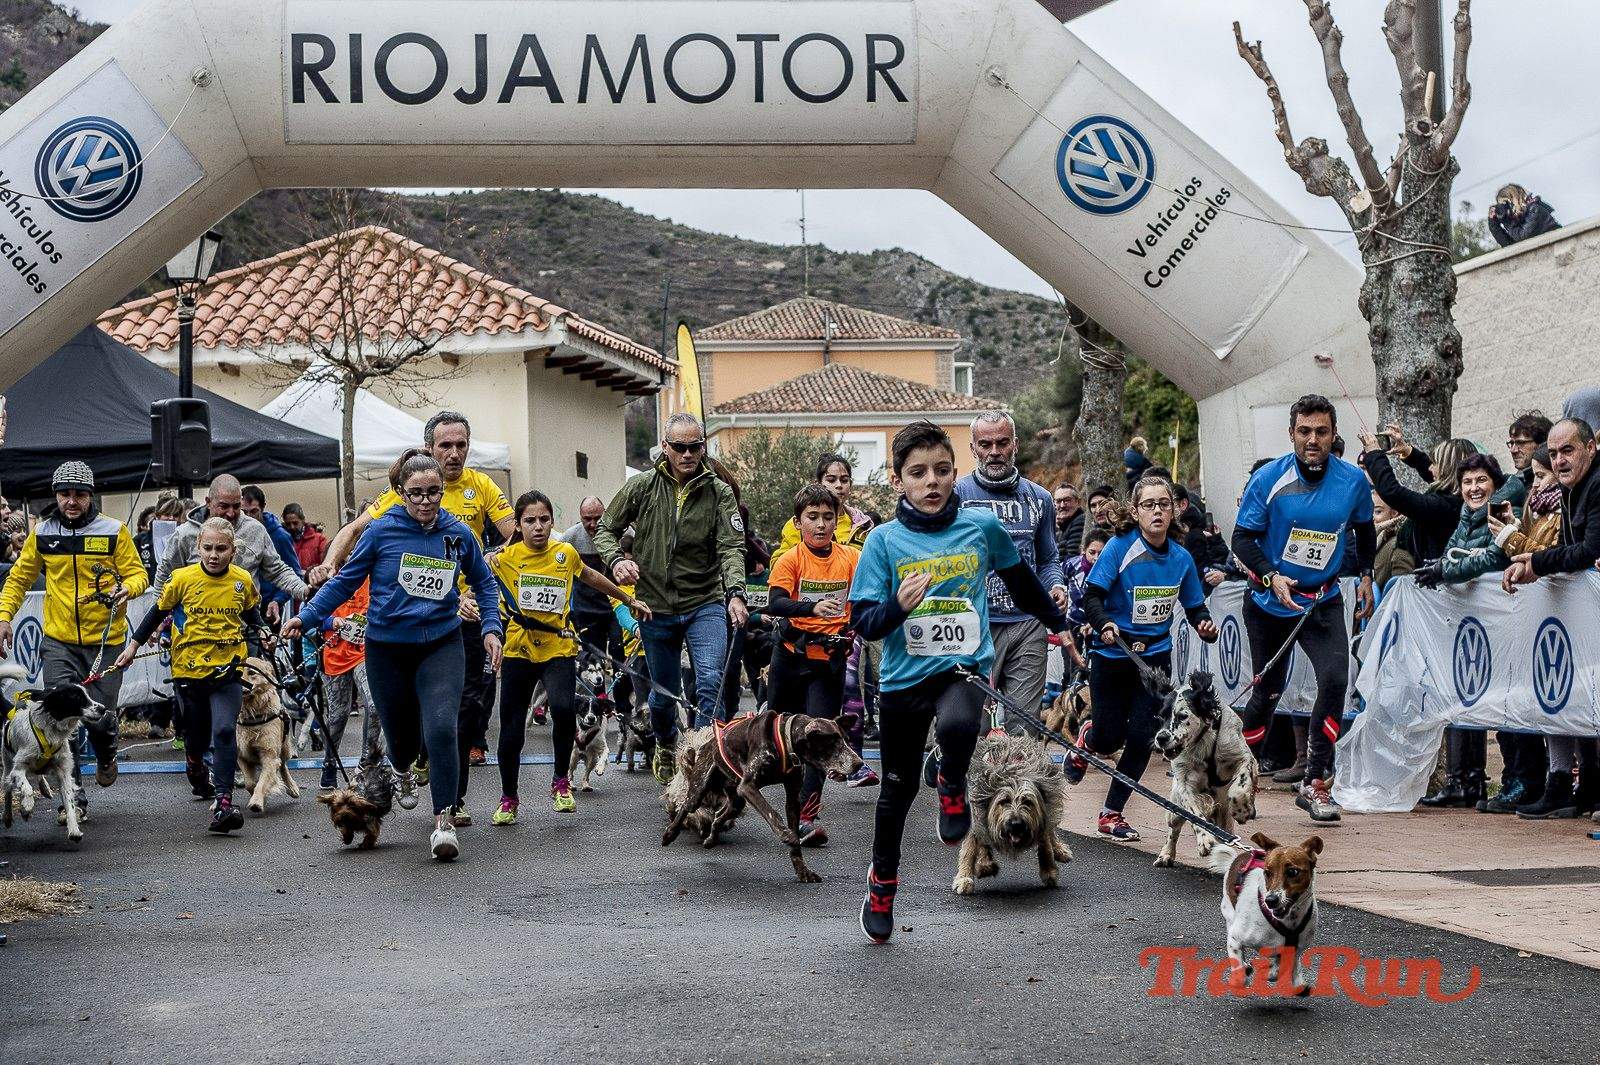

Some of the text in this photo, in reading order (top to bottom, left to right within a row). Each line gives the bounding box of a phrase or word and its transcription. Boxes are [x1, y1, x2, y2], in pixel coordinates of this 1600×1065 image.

[1126, 177, 1203, 258] Vehículos
[1143, 187, 1231, 288] Comerciales
[443, 535, 463, 560] M
[1306, 547, 1323, 561] 31
[416, 575, 444, 591] 220
[536, 591, 558, 606] 217
[1136, 588, 1157, 596] RIOJA
[188, 607, 240, 615] RIOJA MOTO
[939, 601, 968, 611] MOTO
[1151, 603, 1171, 616] 209
[931, 624, 965, 642] 200
